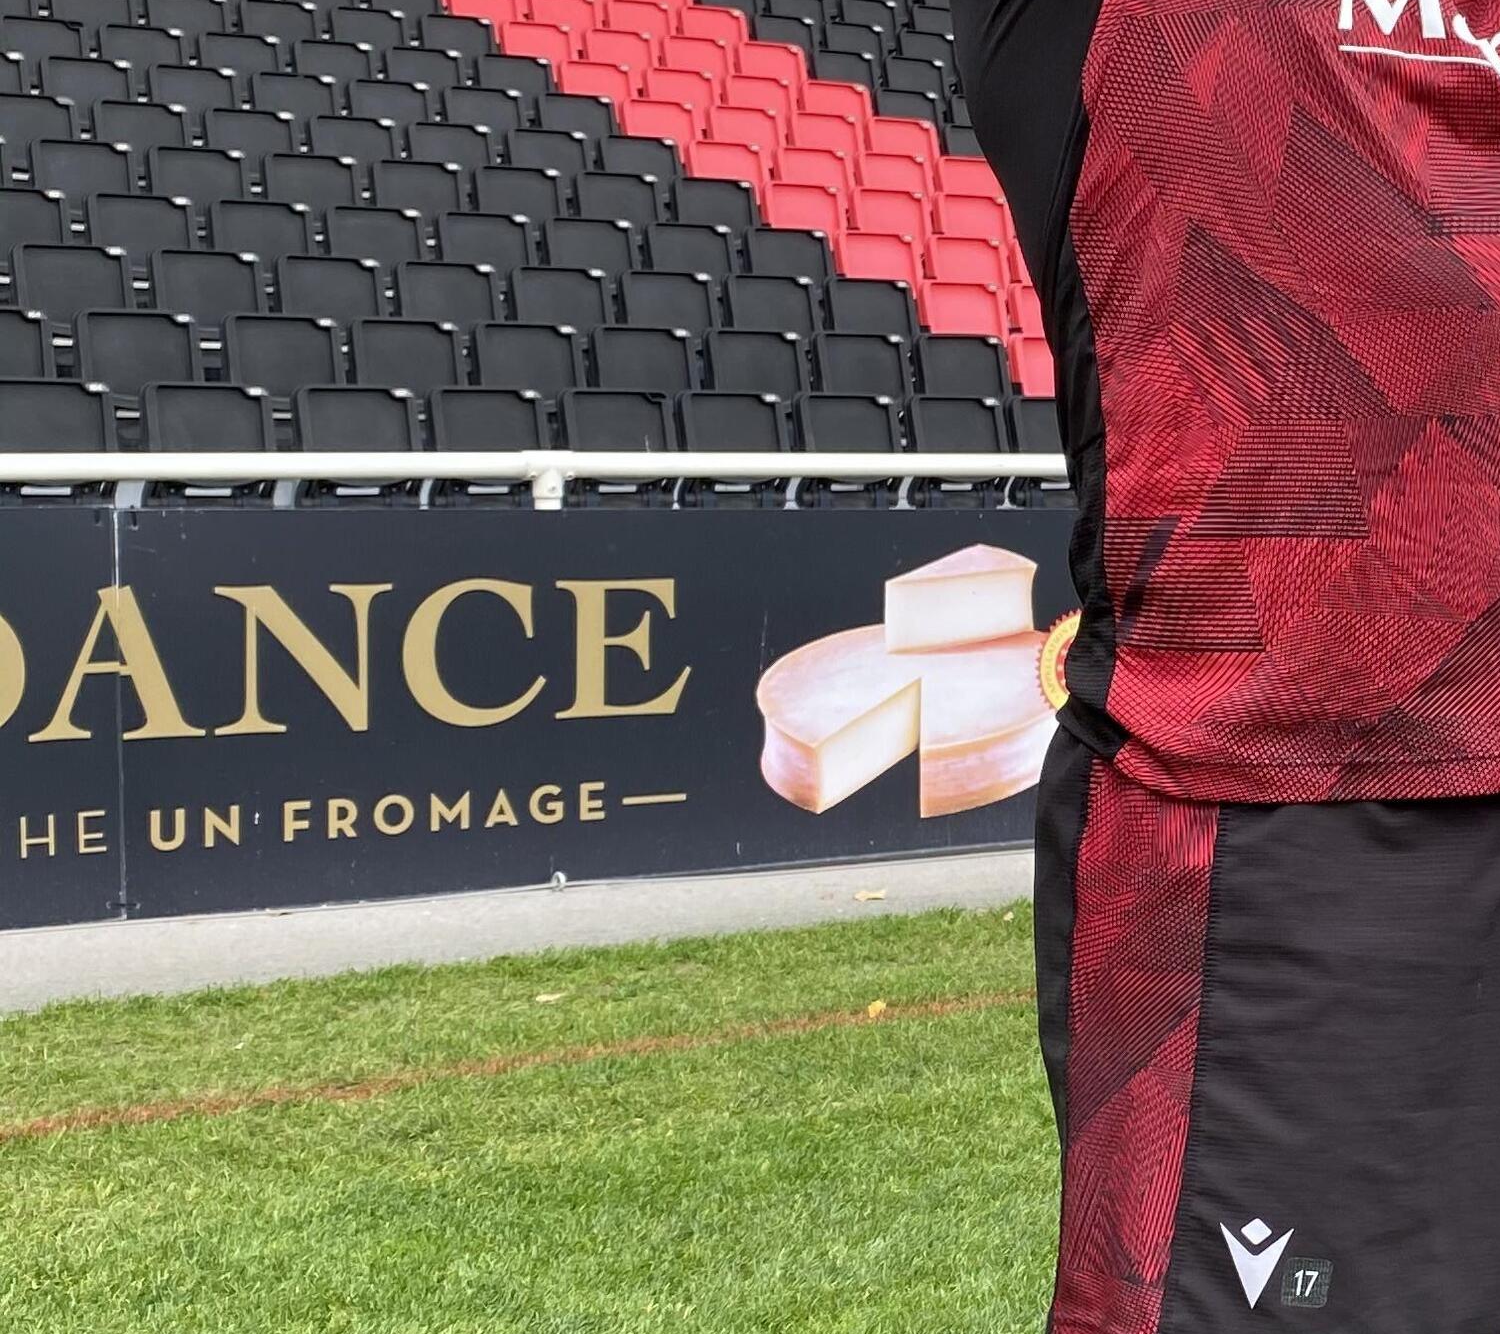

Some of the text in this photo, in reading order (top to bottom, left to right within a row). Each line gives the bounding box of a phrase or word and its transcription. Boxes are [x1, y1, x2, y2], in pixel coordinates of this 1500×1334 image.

[0, 578, 692, 742] ANCE
[149, 804, 241, 852] UN
[282, 781, 606, 843] FROMAGE
[1293, 1269, 1319, 1297] 17
